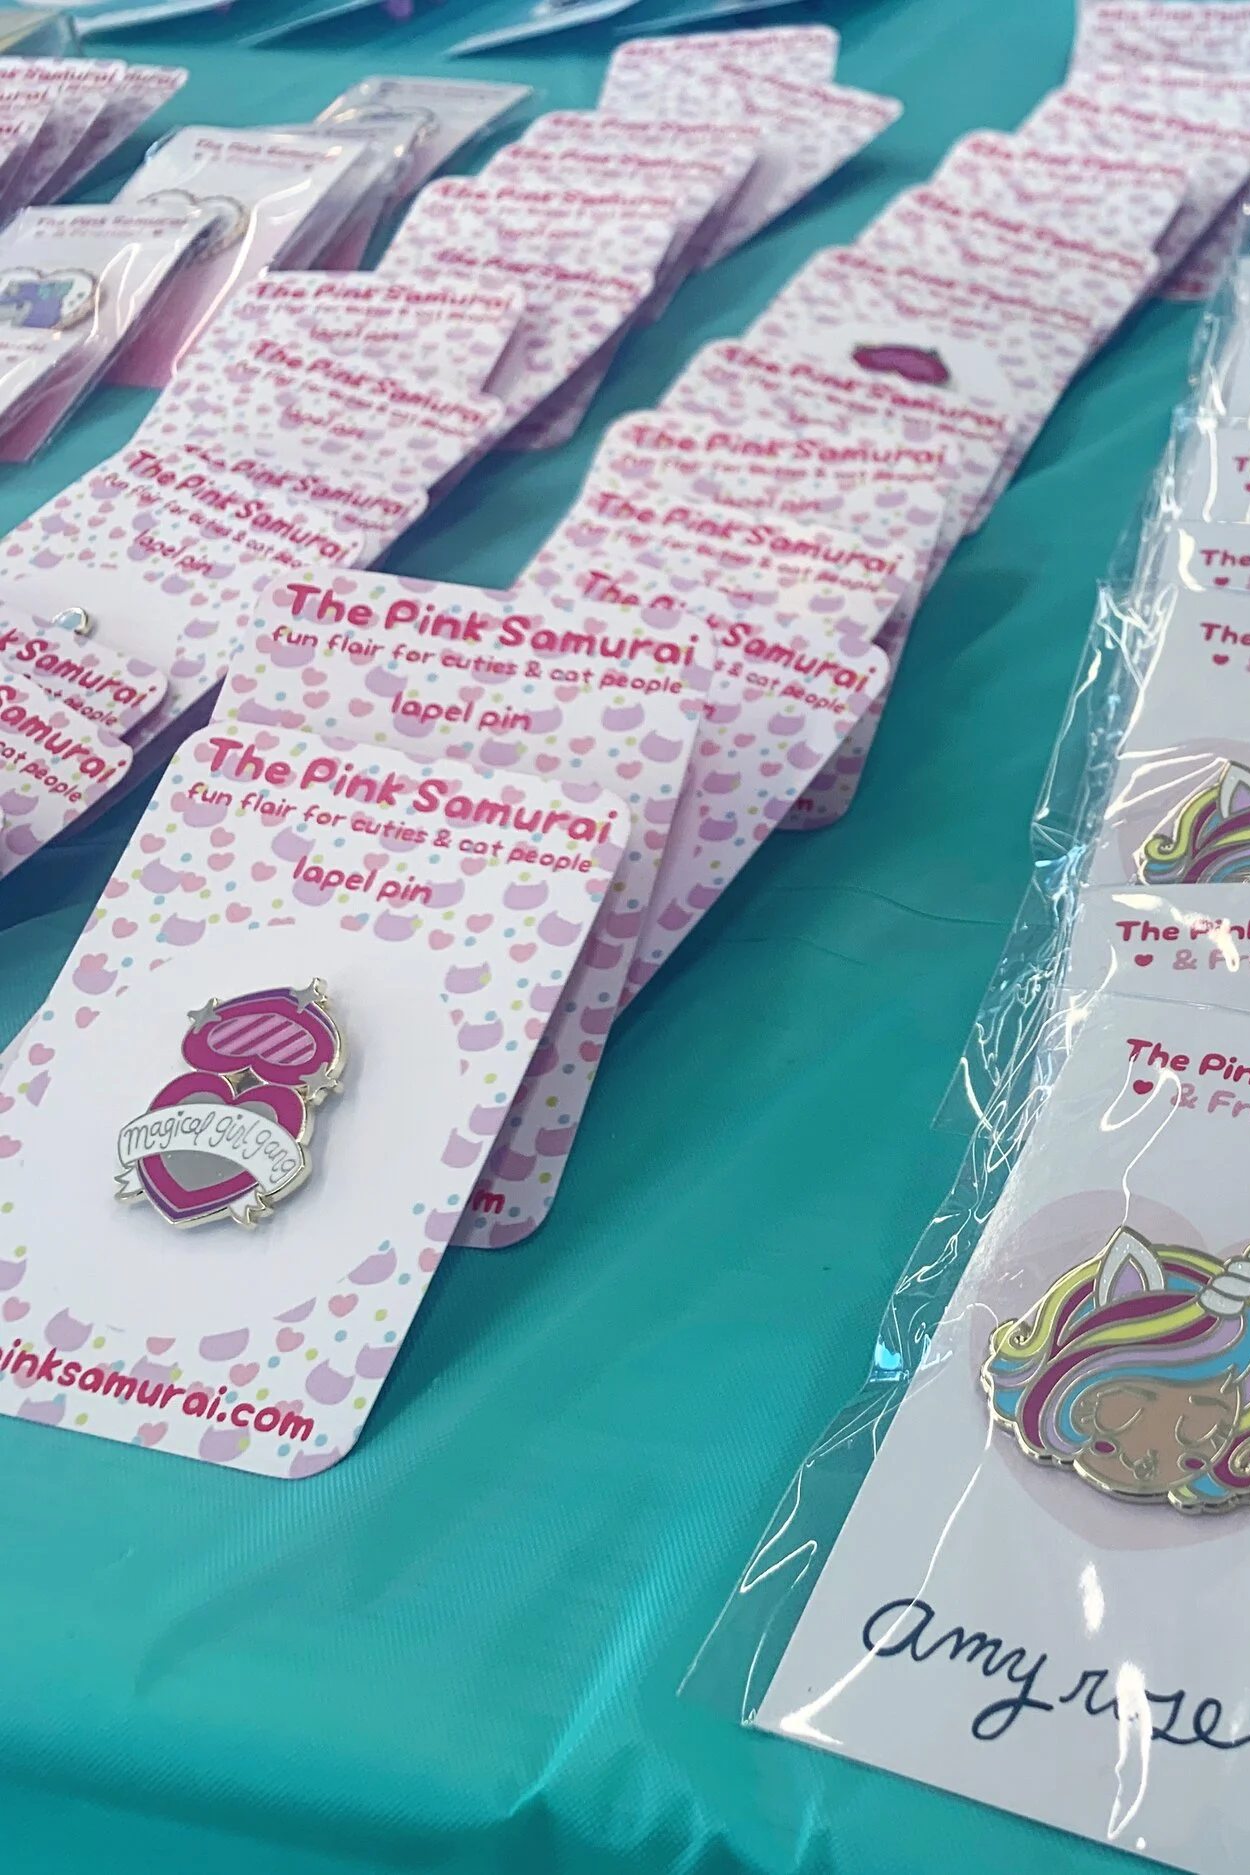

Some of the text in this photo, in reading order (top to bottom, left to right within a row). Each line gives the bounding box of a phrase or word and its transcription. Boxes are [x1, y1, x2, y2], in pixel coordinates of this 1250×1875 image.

[285, 582, 701, 667] The Pink Samurai
[16, 638, 157, 707] Samurai
[272, 626, 683, 694] fun flair for cuties & cat people
[391, 692, 531, 732] lapel pin
[208, 736, 620, 844] The Pink Samurai
[188, 783, 592, 873] fun flair for cuties & cat people
[293, 856, 432, 904] lapel pin
[1116, 921, 1180, 941] The
[1172, 949, 1198, 969] &
[1127, 1040, 1192, 1071] The
[1170, 1081, 1200, 1110] &
[862, 1598, 1054, 1740] amy
